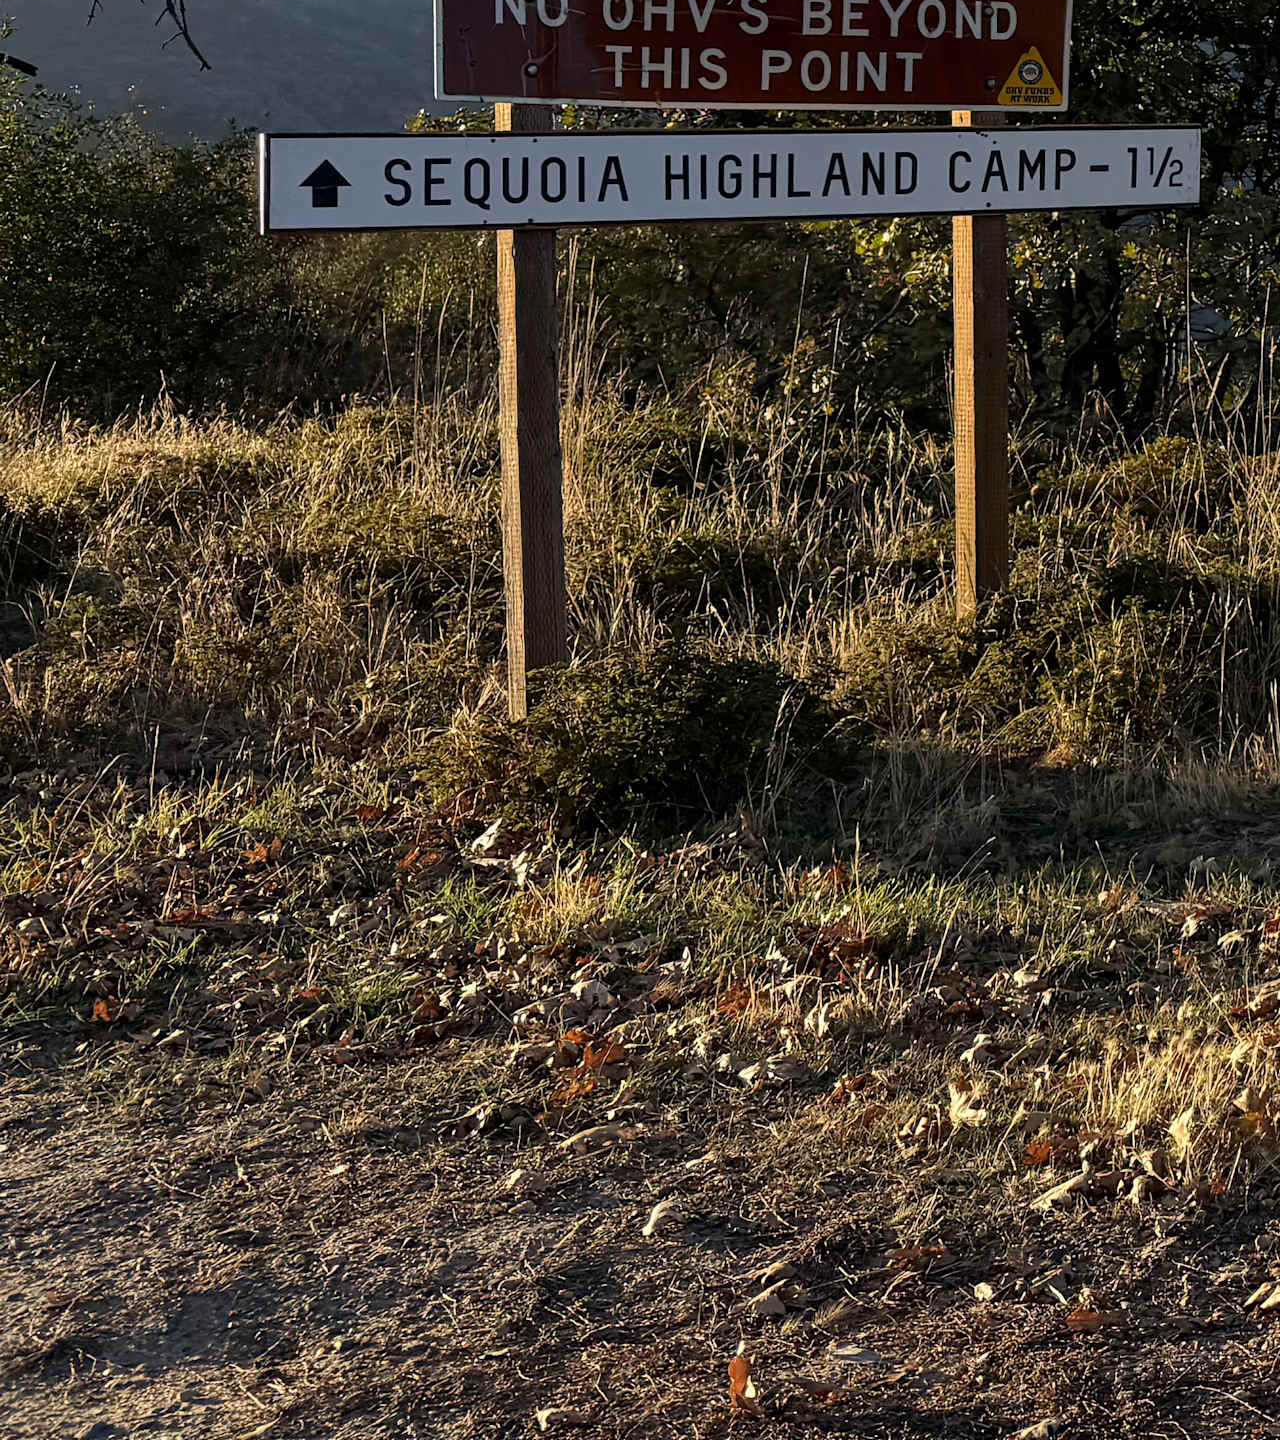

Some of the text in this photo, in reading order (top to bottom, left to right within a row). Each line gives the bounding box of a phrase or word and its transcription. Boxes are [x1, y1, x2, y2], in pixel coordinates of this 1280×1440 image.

[605, 45, 923, 93] THIS POINT
[383, 156, 629, 209] SEQUOIA
[664, 151, 919, 200] HIGHLAND
